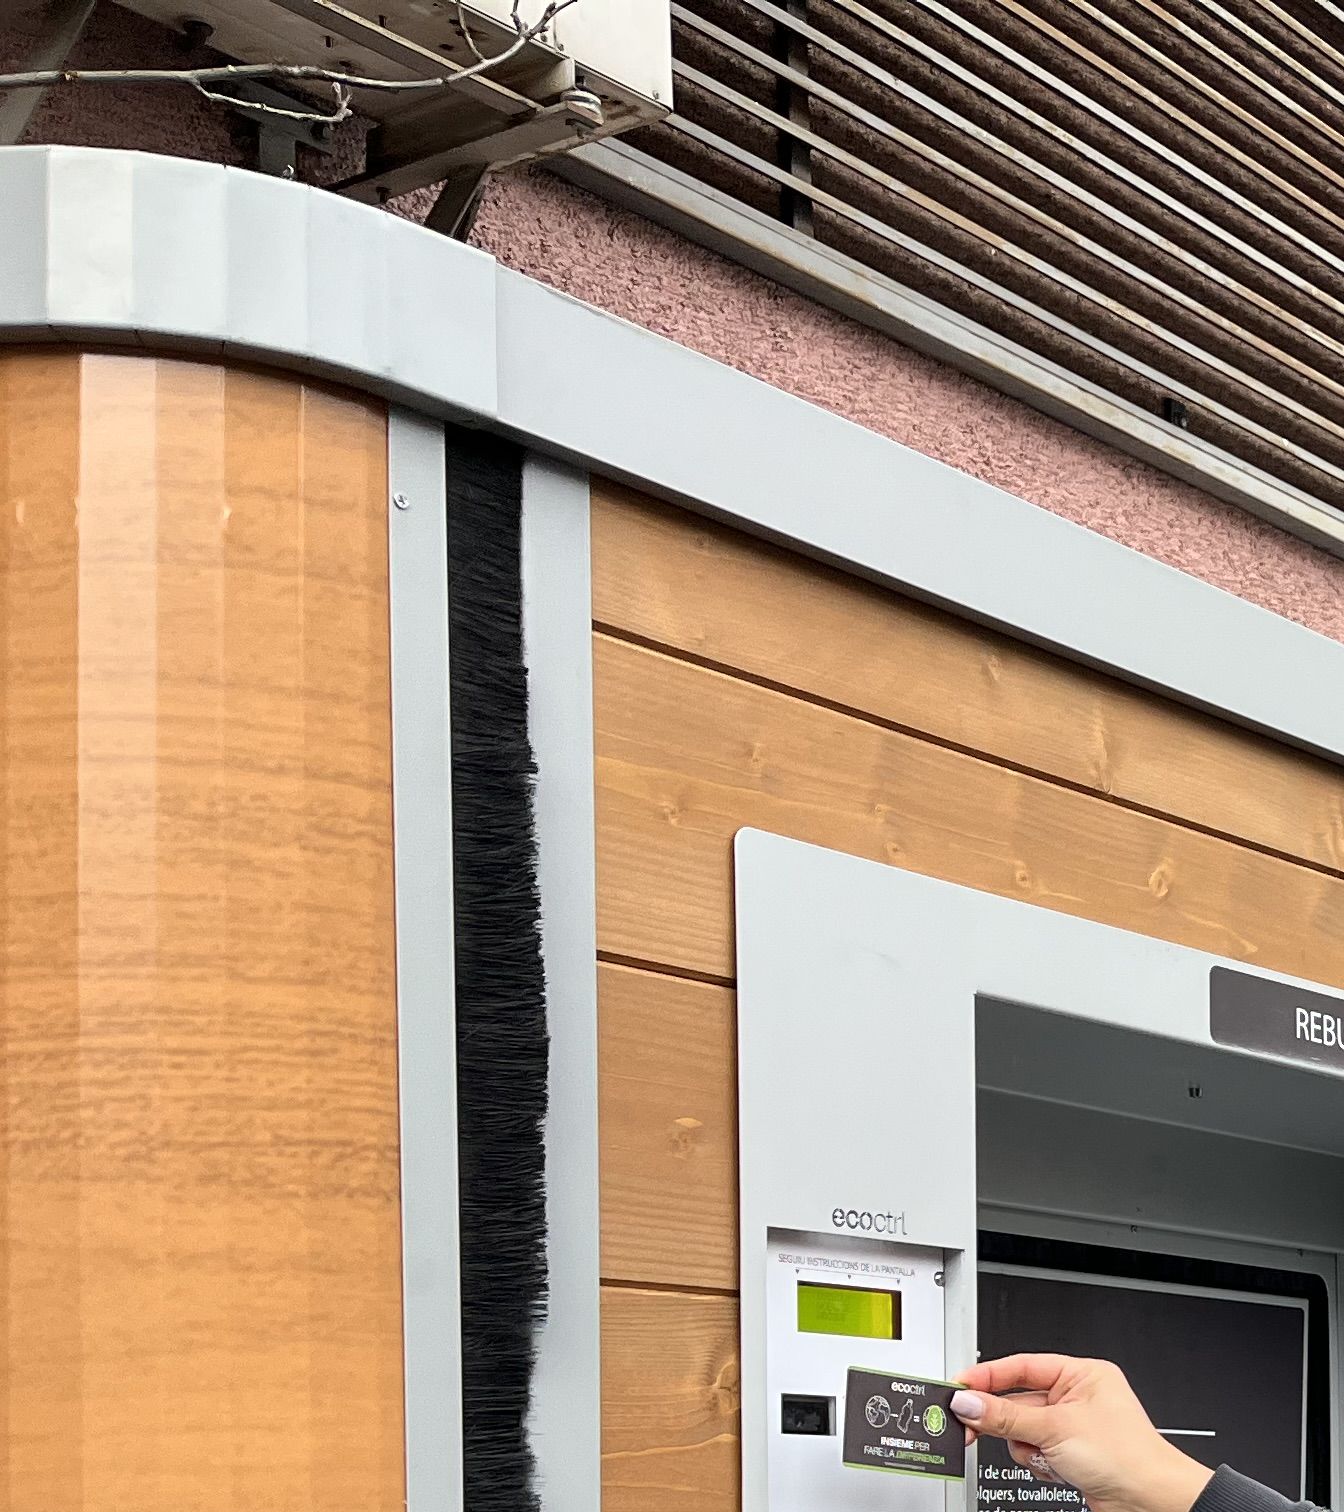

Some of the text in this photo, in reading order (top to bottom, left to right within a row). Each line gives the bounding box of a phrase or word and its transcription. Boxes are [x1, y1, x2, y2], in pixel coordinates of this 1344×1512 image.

[832, 1207, 908, 1235] ecoctrl
[860, 1262, 870, 1273] DE
[871, 1264, 880, 1274] LA
[881, 1264, 916, 1278] PANTALLA
[891, 1382, 926, 1396] ecoctrl
[984, 1465, 1000, 1480] de
[1001, 1464, 1034, 1482] cuina,
[1017, 1486, 1080, 1504] tovalloletes,
